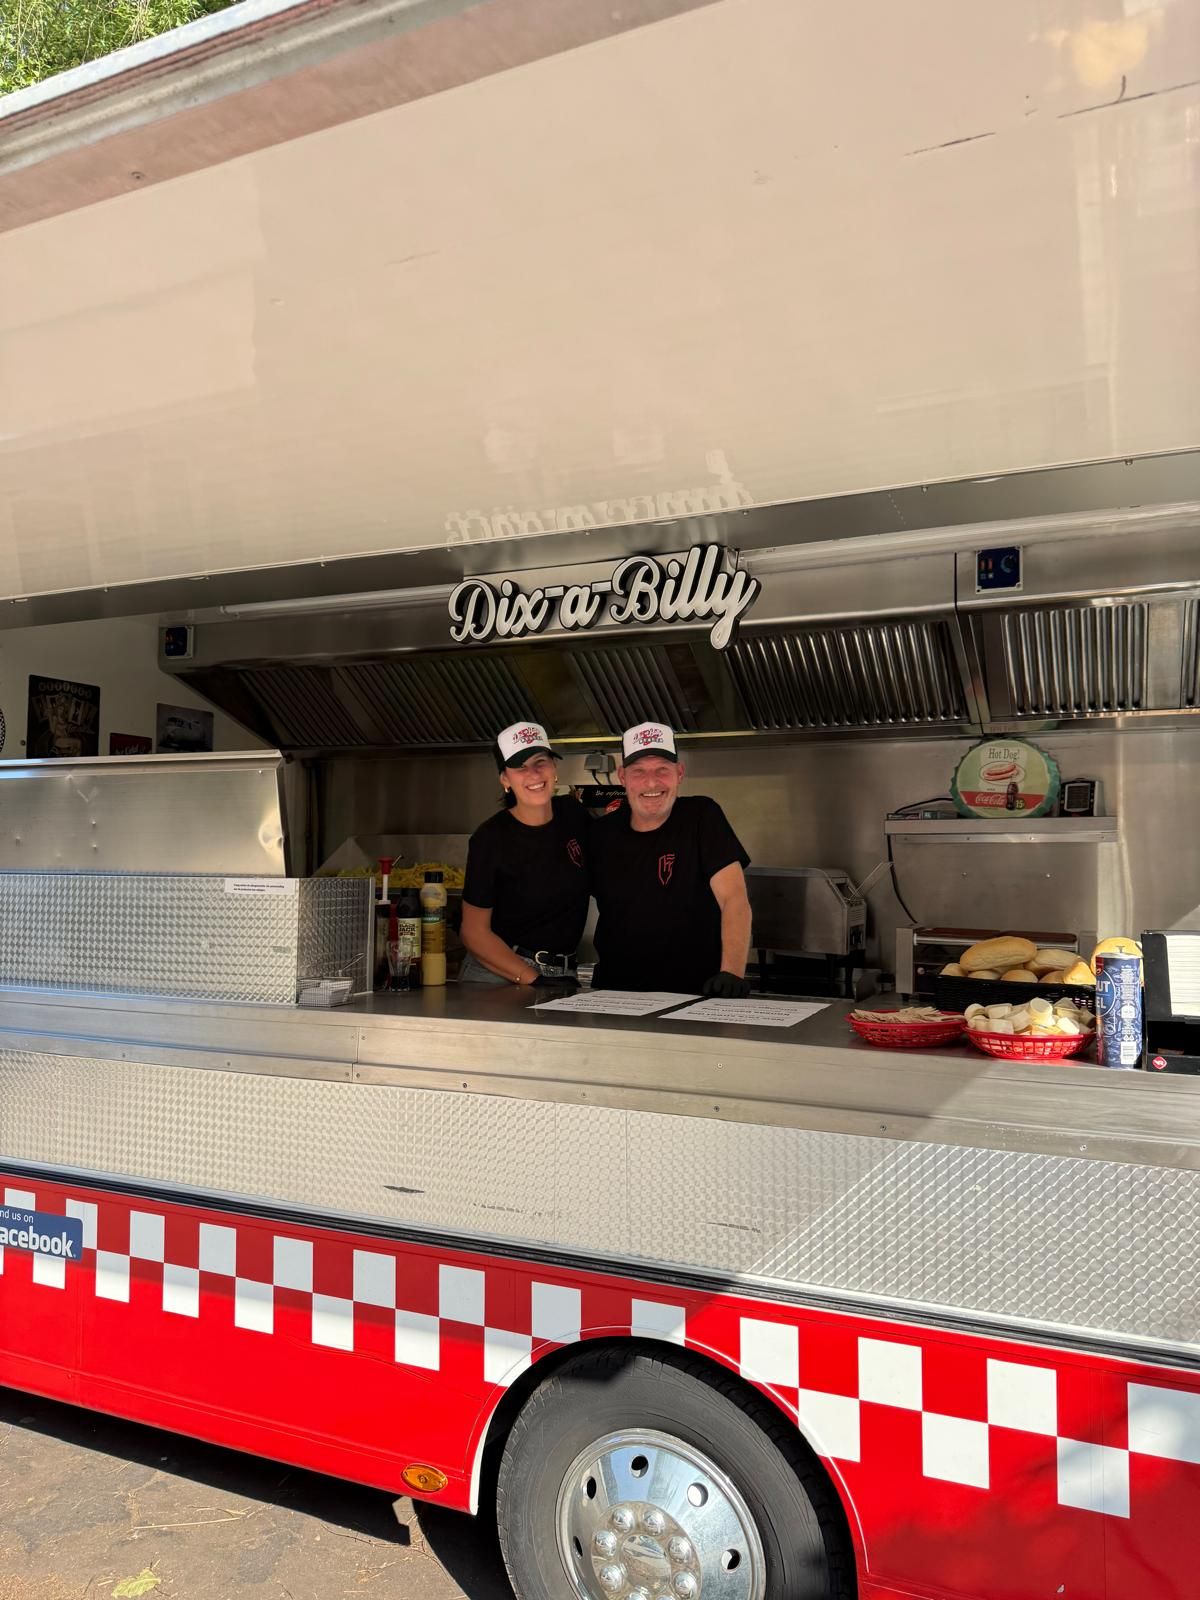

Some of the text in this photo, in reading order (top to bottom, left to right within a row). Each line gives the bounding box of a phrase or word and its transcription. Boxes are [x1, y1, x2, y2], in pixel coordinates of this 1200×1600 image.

[448, 544, 761, 650] Dix-a-Billy
[988, 748, 1020, 760] Hot Dog!
[11, 1213, 21, 1221] us
[23, 1214, 34, 1224] on
[0, 1225, 74, 1258] acebook
